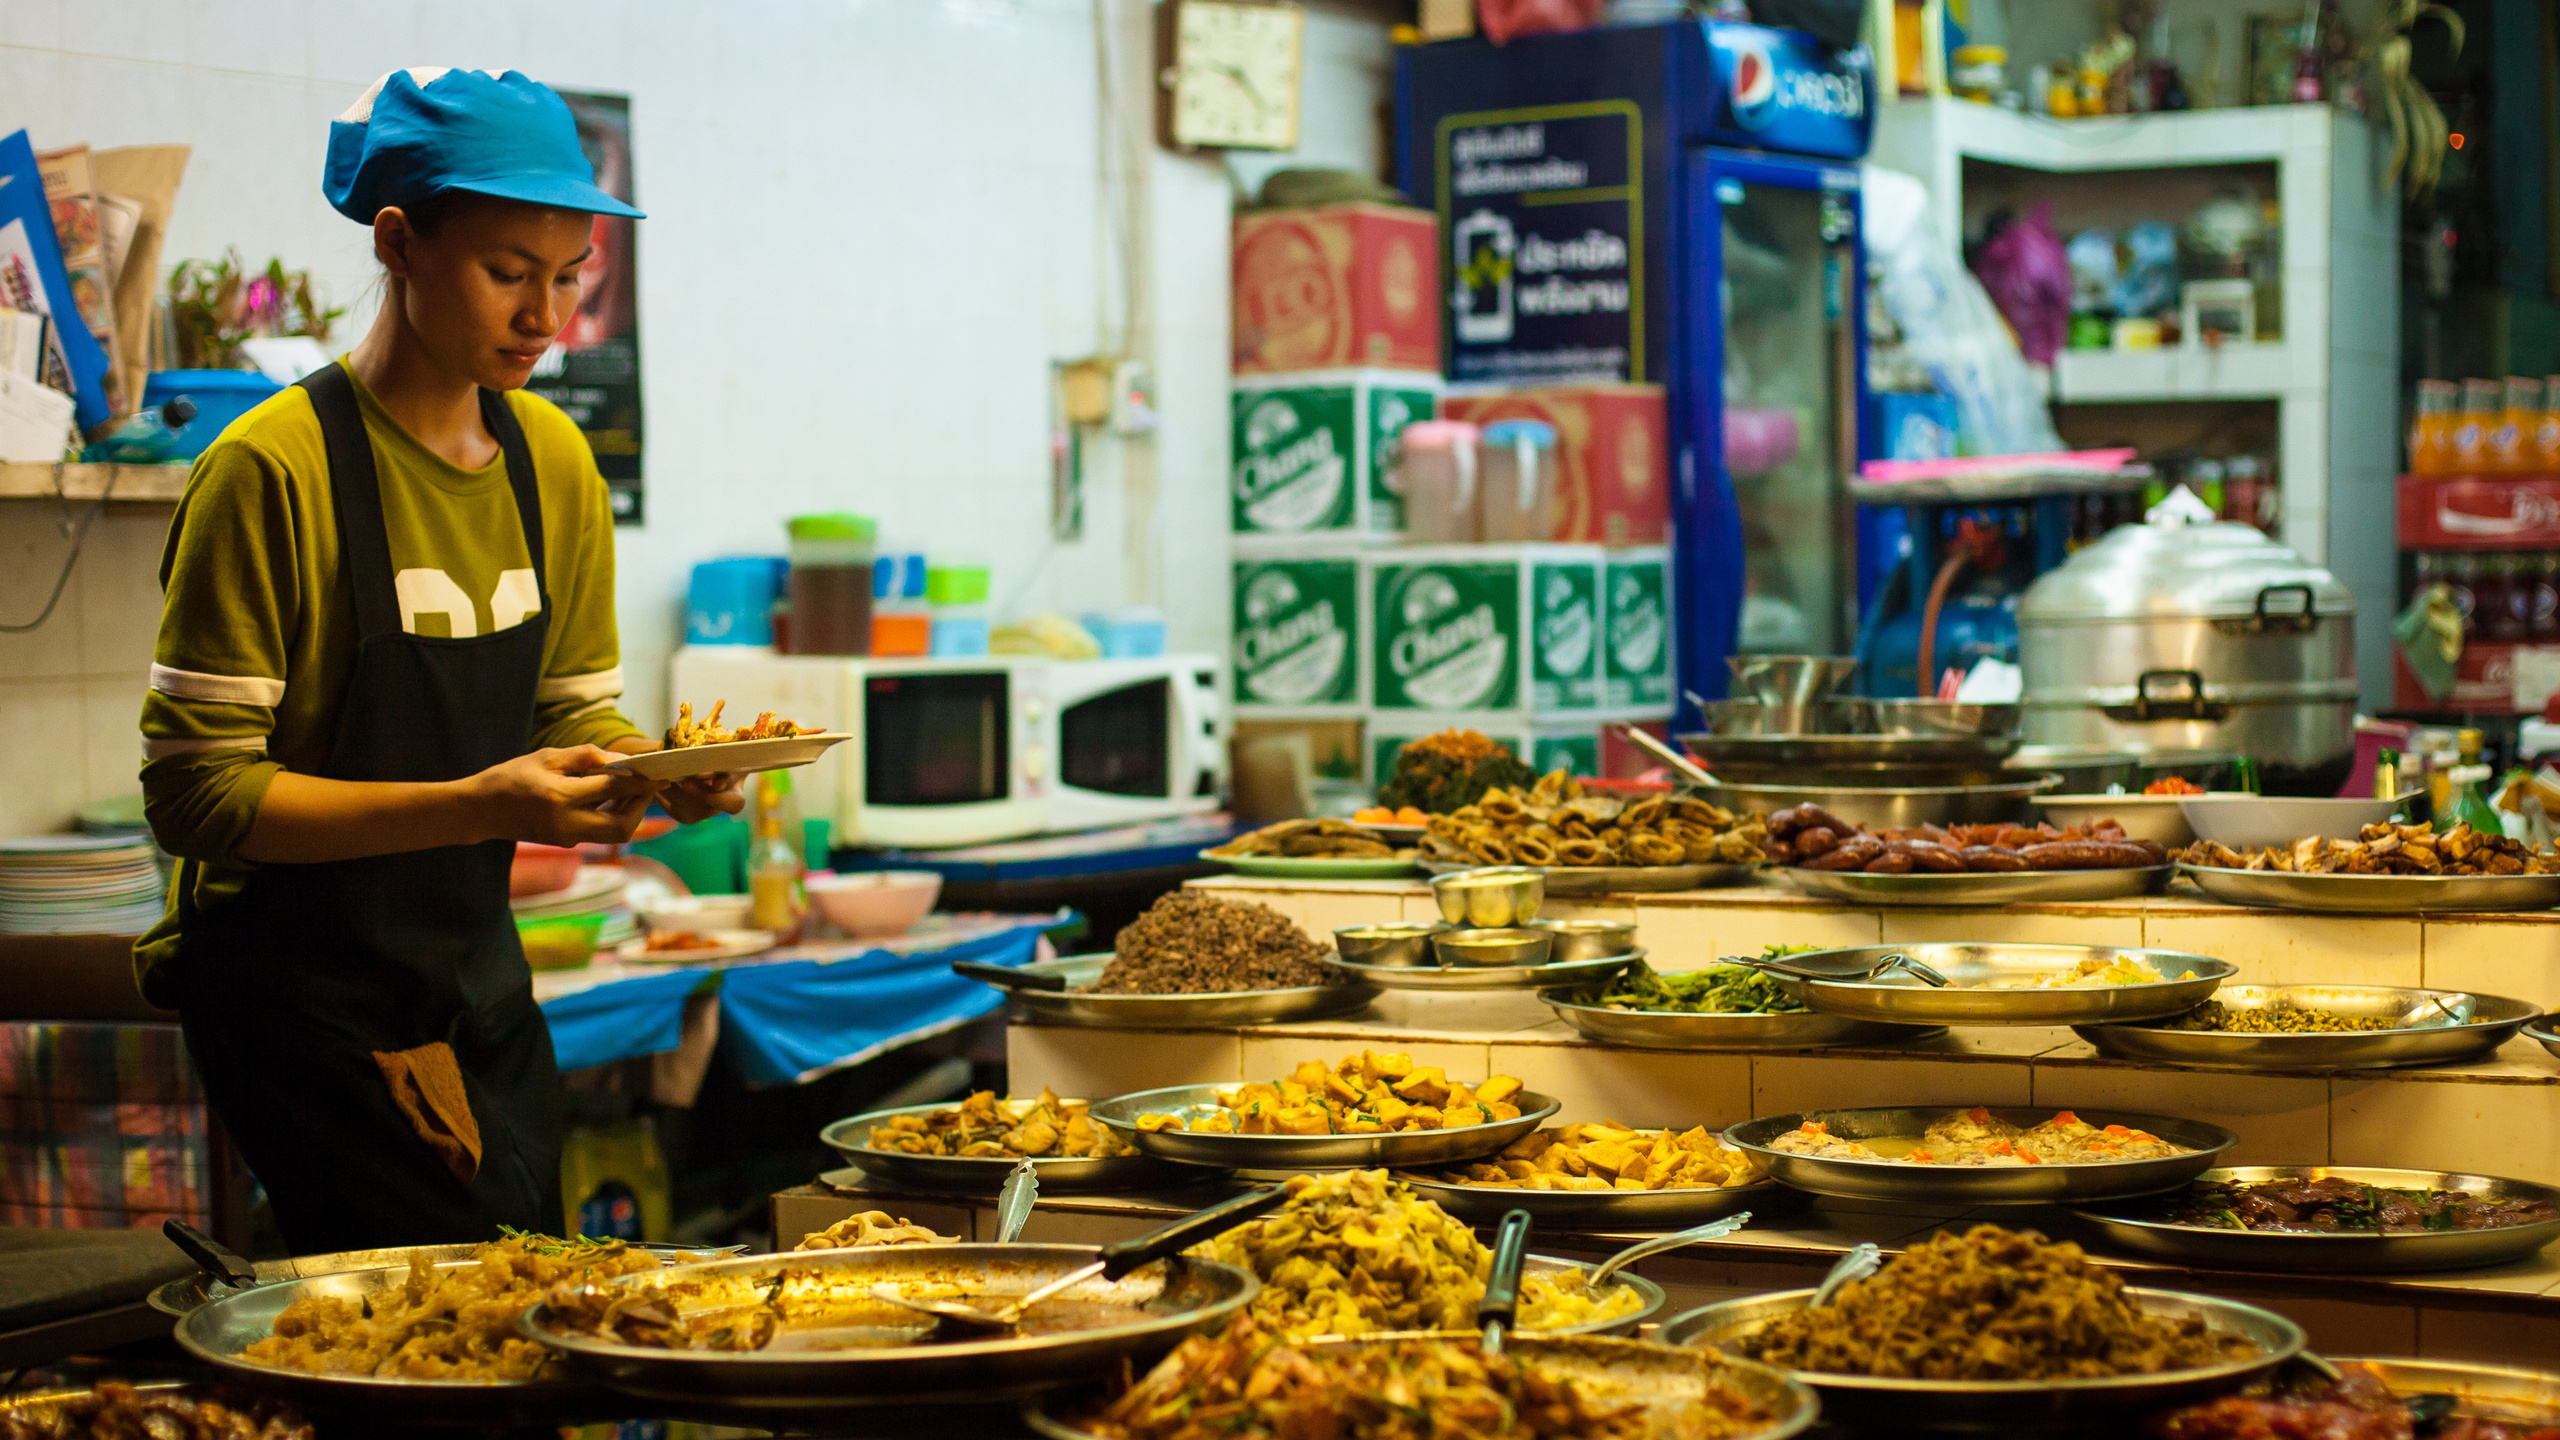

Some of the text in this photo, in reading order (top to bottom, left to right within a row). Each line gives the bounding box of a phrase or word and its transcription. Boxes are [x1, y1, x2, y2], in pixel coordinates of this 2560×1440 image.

[1236, 426, 1335, 500] Chang
[1235, 599, 1335, 671] Chang
[1390, 604, 1496, 676] Chang
